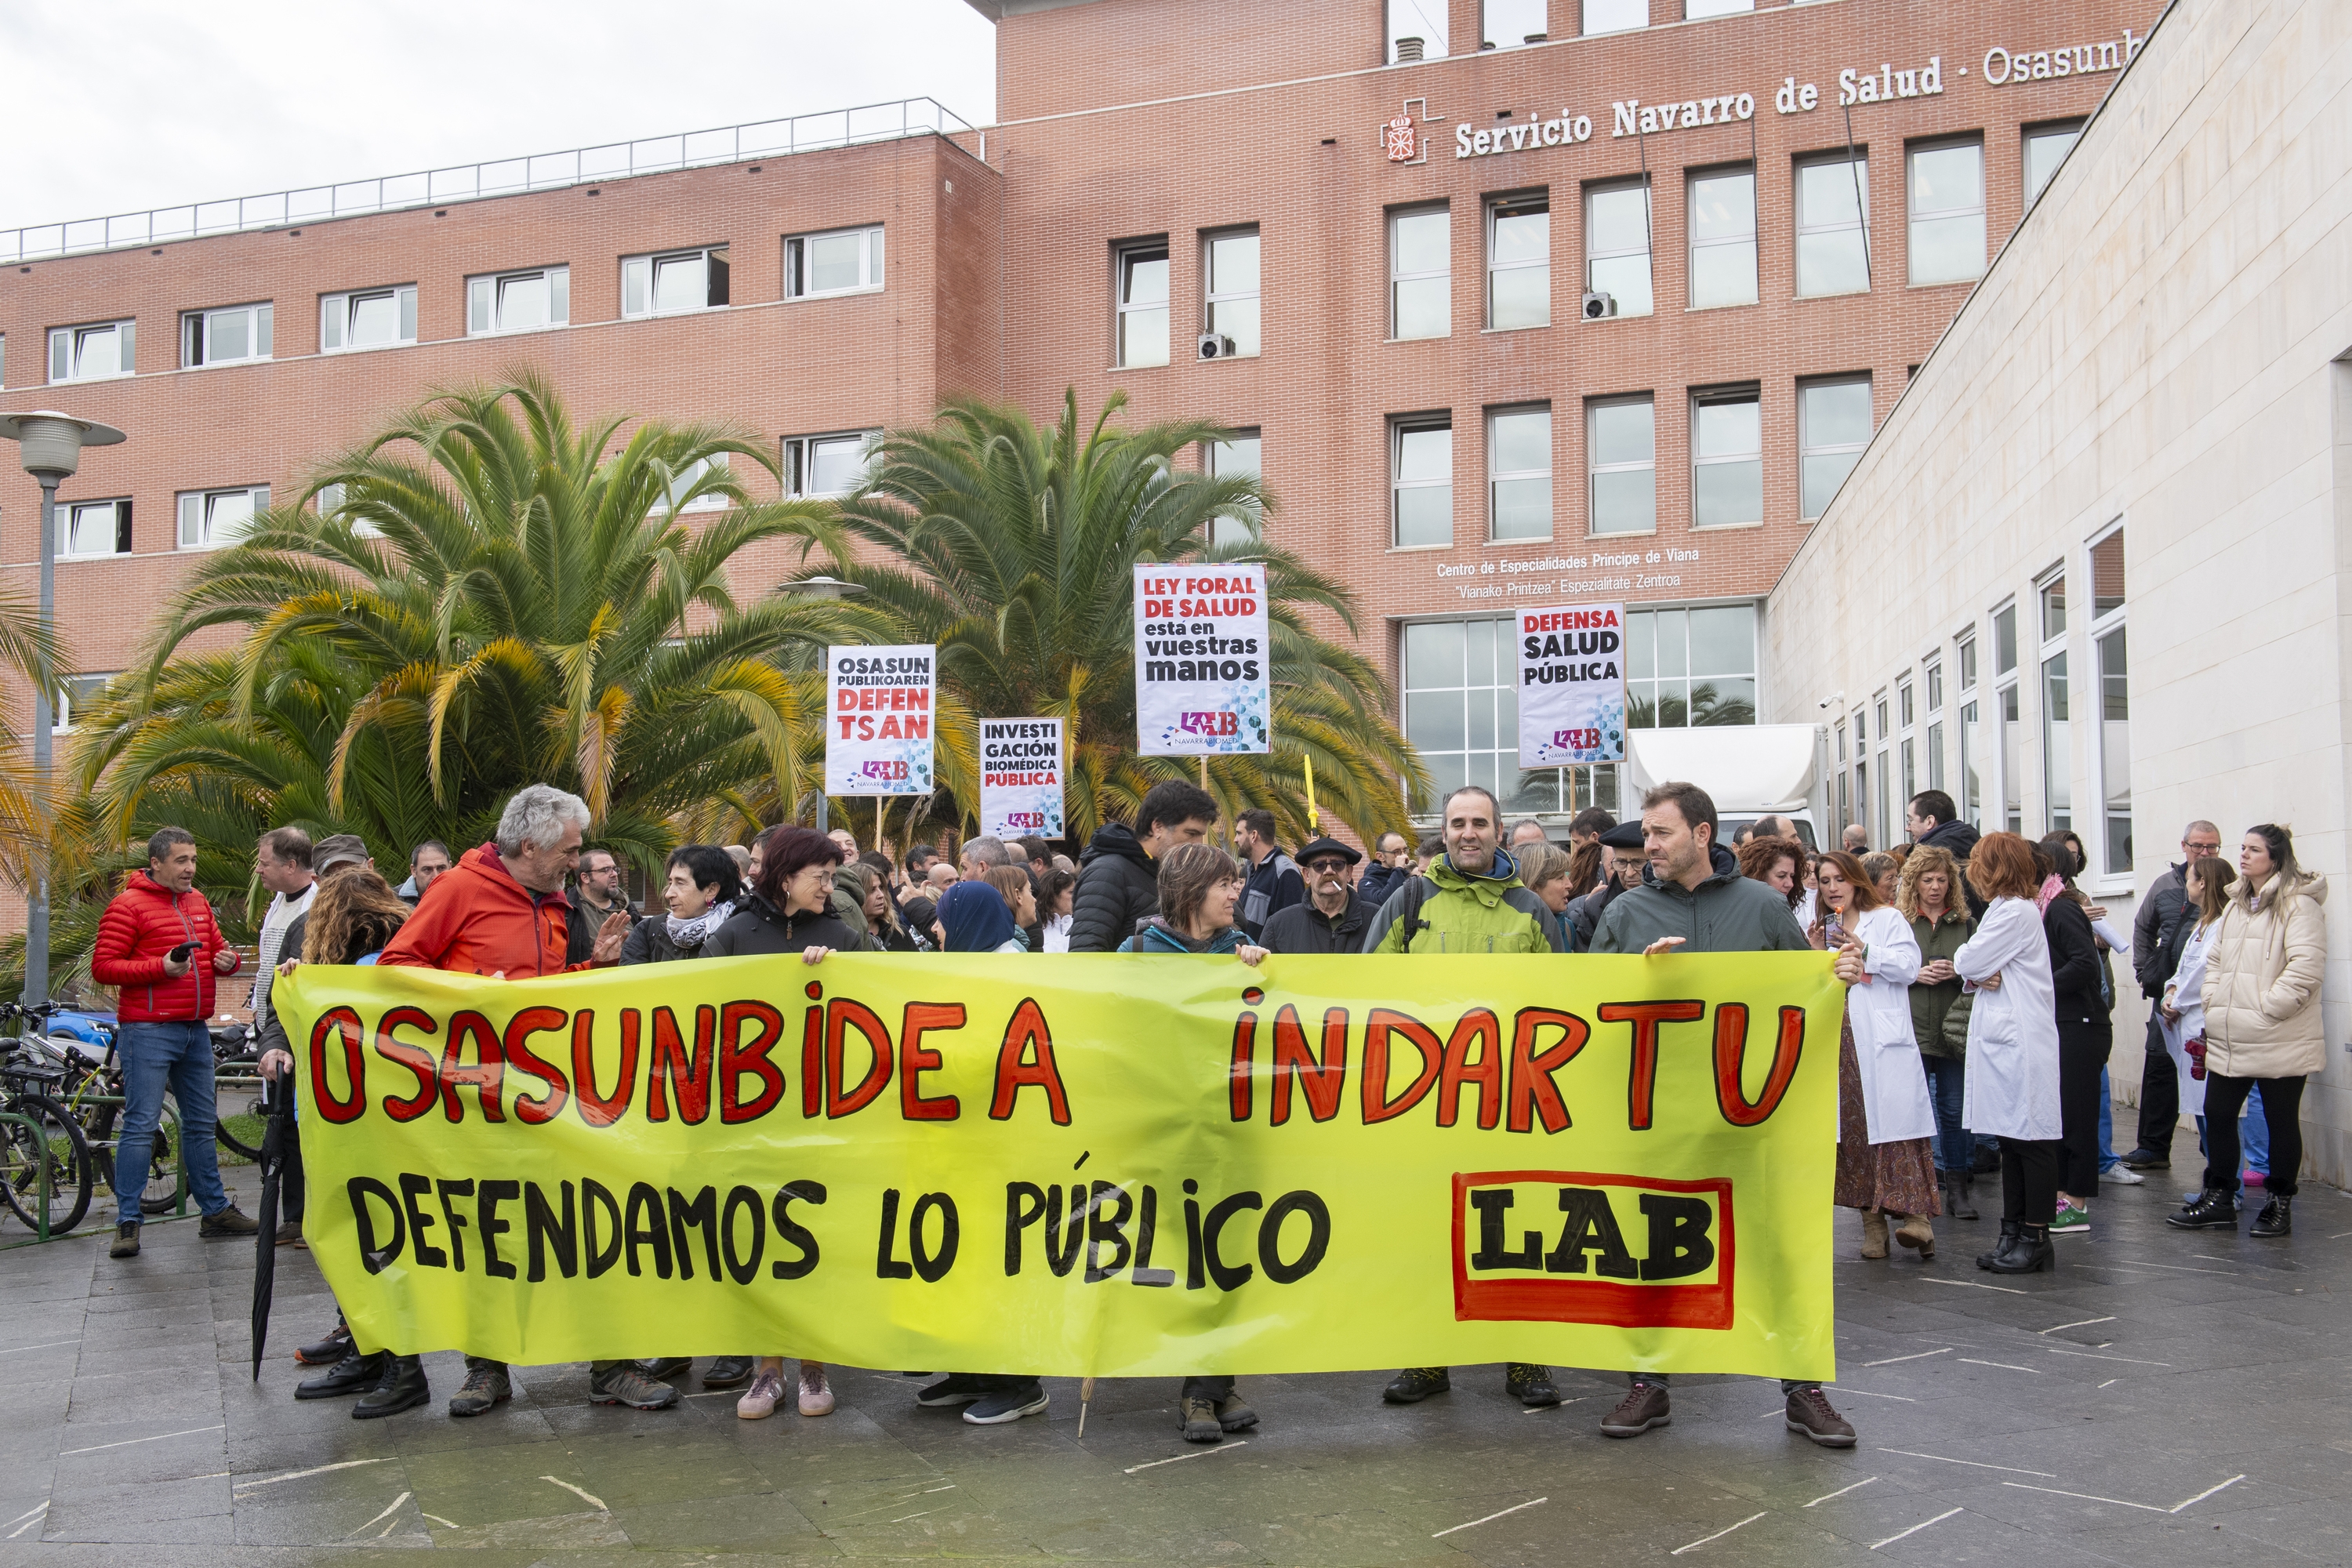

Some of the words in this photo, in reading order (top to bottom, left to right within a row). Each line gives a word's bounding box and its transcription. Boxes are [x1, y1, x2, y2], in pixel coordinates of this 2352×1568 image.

[1456, 107, 1592, 158] Servicio
[1612, 93, 1755, 137] Navarro
[1776, 77, 1818, 114] de
[1839, 56, 1943, 106] Salud
[1437, 563, 1475, 577] Centro
[1480, 561, 1495, 574] de
[1500, 555, 1588, 575] Especialidades
[1592, 552, 1640, 568] Principe
[1646, 550, 1661, 564] de
[1666, 548, 1700, 561] Viana
[1144, 578, 1181, 596] LEY
[1186, 577, 1257, 595] FORAL
[1560, 576, 1631, 594] Espezialitate
[1636, 574, 1681, 588] Zentroa
[1145, 599, 1174, 618] DE
[1179, 598, 1257, 618] SALUD
[1191, 622, 1214, 635] en
[1523, 609, 1619, 633] DEFENSA
[1145, 637, 1258, 656] vuestras
[1524, 630, 1620, 659] SALUD
[837, 657, 930, 673] OSASUN
[1145, 659, 1259, 681] manos
[1524, 662, 1620, 685] PÚBLICA
[837, 675, 929, 686] PUBLIKOAREN
[837, 688, 929, 711] DEFEN
[837, 715, 928, 741] TSAN
[985, 724, 1056, 739] INVESTI
[1181, 712, 1238, 735] LAB
[985, 739, 1057, 757] GACIÓN
[1553, 728, 1600, 750] LAB
[1548, 750, 1600, 758] NAVARRABIOMED
[862, 760, 909, 780] LAB
[985, 758, 1057, 771] BIOMÉDICA
[985, 771, 1057, 787] PÚBLICA
[1007, 811, 1044, 828] LAB
[347, 1172, 827, 1285] DEFENDAMOS
[877, 1187, 959, 1283] LO
[1004, 1151, 1331, 1292] PÚBLICO
[1469, 1185, 1715, 1282] LAB
